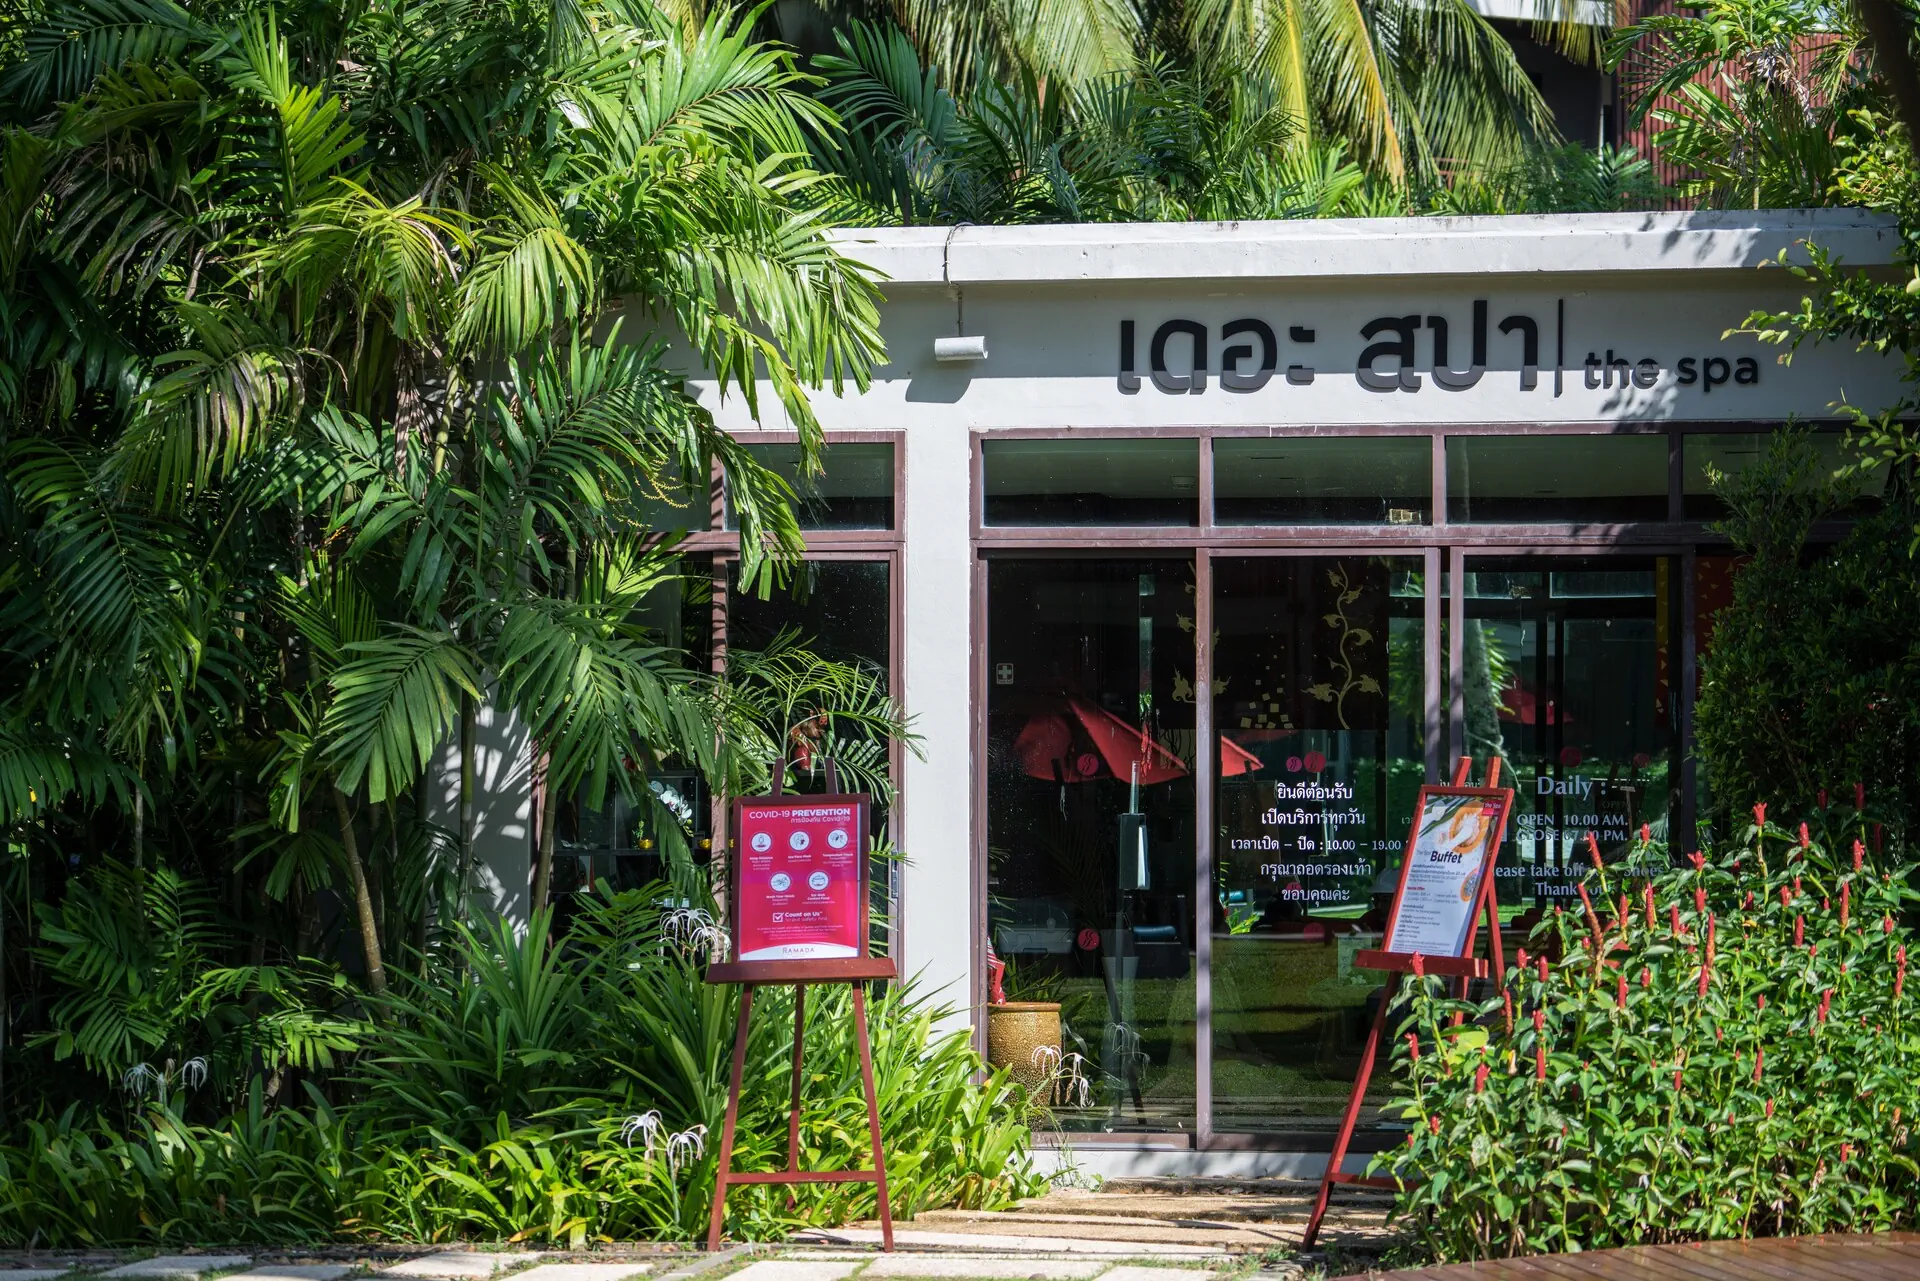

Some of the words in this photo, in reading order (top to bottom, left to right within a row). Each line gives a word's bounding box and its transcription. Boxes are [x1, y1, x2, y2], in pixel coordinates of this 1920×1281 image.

[1117, 318, 1315, 395] เดอะ
[1355, 300, 1539, 393] สปา
[1585, 350, 1660, 389] the
[1677, 356, 1758, 393] spa
[1277, 782, 1353, 800] ยินดีต้อนรับ
[1537, 775, 1593, 801] Daily
[749, 810, 790, 819] COVID-19
[791, 808, 850, 818] PREVENTION
[1261, 808, 1366, 831] เปิดบริการทุกวัน
[1516, 814, 1555, 826] OPEN
[1563, 814, 1599, 826] 10.00
[1602, 814, 1629, 826] AM.
[1231, 836, 1280, 851] เวลาเปิด
[1297, 836, 1315, 851] ปิด
[1327, 840, 1356, 851] 10.00
[1372, 840, 1402, 851] 19.00
[1516, 829, 1560, 842] CLOSE
[1603, 829, 1628, 842] PM.
[1430, 850, 1463, 864] Buffet
[1260, 859, 1371, 881] กรุณาถอดรองเท้า
[1530, 862, 1560, 877] take
[1563, 863, 1584, 877] off
[1282, 884, 1350, 907] ขอบคุณค่ะ
[1535, 881, 1577, 896] Thank
